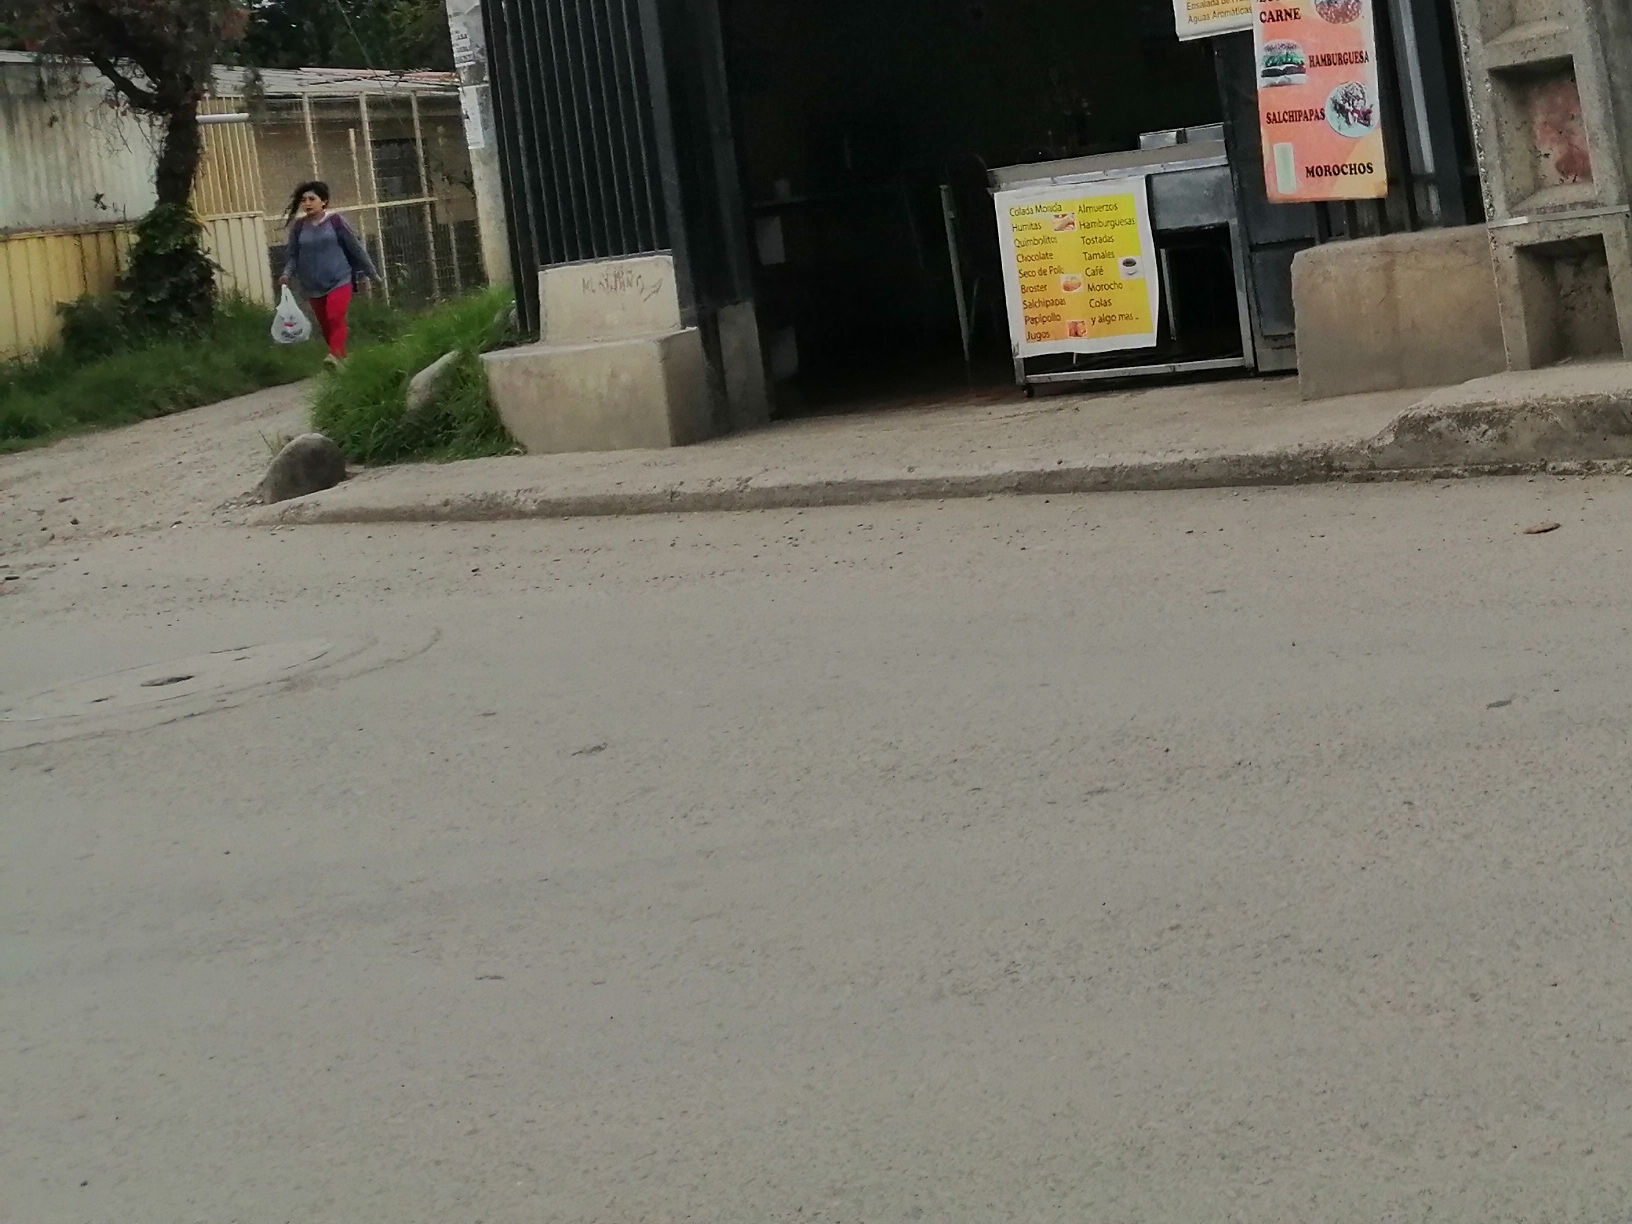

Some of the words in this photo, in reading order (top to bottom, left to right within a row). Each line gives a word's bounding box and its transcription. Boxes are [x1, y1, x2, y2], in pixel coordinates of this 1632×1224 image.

[1187, 0, 1220, 10] Ensalada
[1188, 14, 1210, 25] Aguas
[1260, 8, 1301, 23] CARNE
[1309, 51, 1369, 68] HAMBURGUESA
[1266, 108, 1326, 124] SALCHIPAPAS
[1305, 162, 1374, 178] MOROCHOS
[1010, 207, 1033, 216] Colada
[1078, 203, 1118, 214] Almuerzos
[1012, 222, 1042, 232] Humitas
[1079, 218, 1135, 229] Hamburguesas
[1080, 235, 1114, 245] Tostadas
[1016, 252, 1053, 263] Chocolate
[1083, 250, 1115, 261] Tamales
[1018, 269, 1036, 278] Seco
[1038, 267, 1047, 276] de
[1085, 266, 1104, 277] Café
[1021, 284, 1047, 294] Broster
[1087, 281, 1123, 292] Morocho
[1023, 298, 1066, 309] Salchipapas
[1089, 297, 1112, 308] Colas
[1025, 313, 1061, 325] Papipollo
[1091, 317, 1096, 326] y
[1098, 314, 1117, 325] algo
[1027, 331, 1050, 341] Jugos
